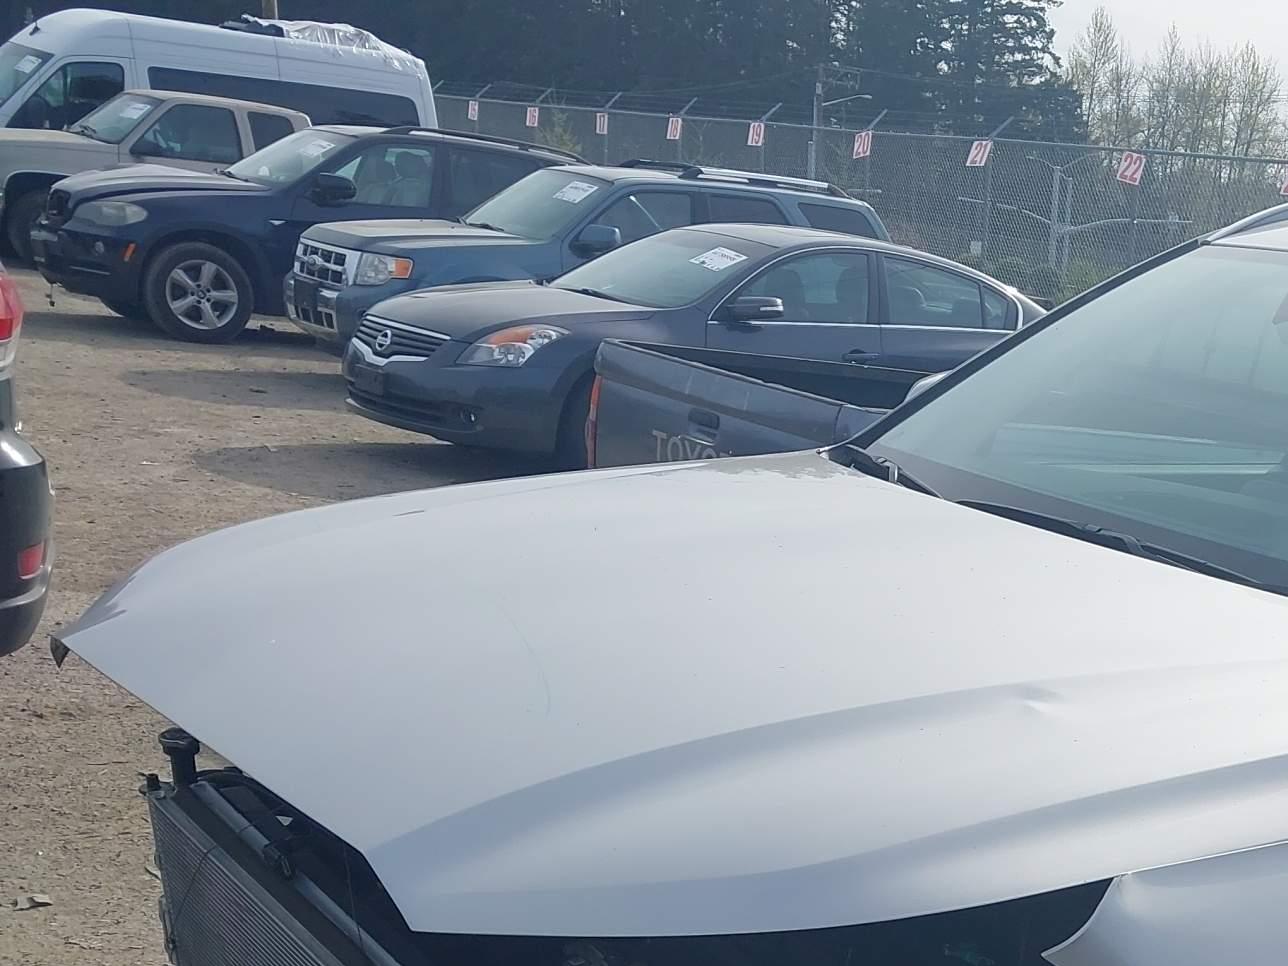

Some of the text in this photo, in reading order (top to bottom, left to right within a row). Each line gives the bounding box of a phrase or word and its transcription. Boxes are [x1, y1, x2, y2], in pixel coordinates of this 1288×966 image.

[528, 107, 538, 126] 16
[669, 118, 679, 138] 18
[750, 123, 764, 144] 19
[854, 132, 871, 157] 20
[971, 141, 992, 165] 21
[1119, 153, 1144, 182] 22
